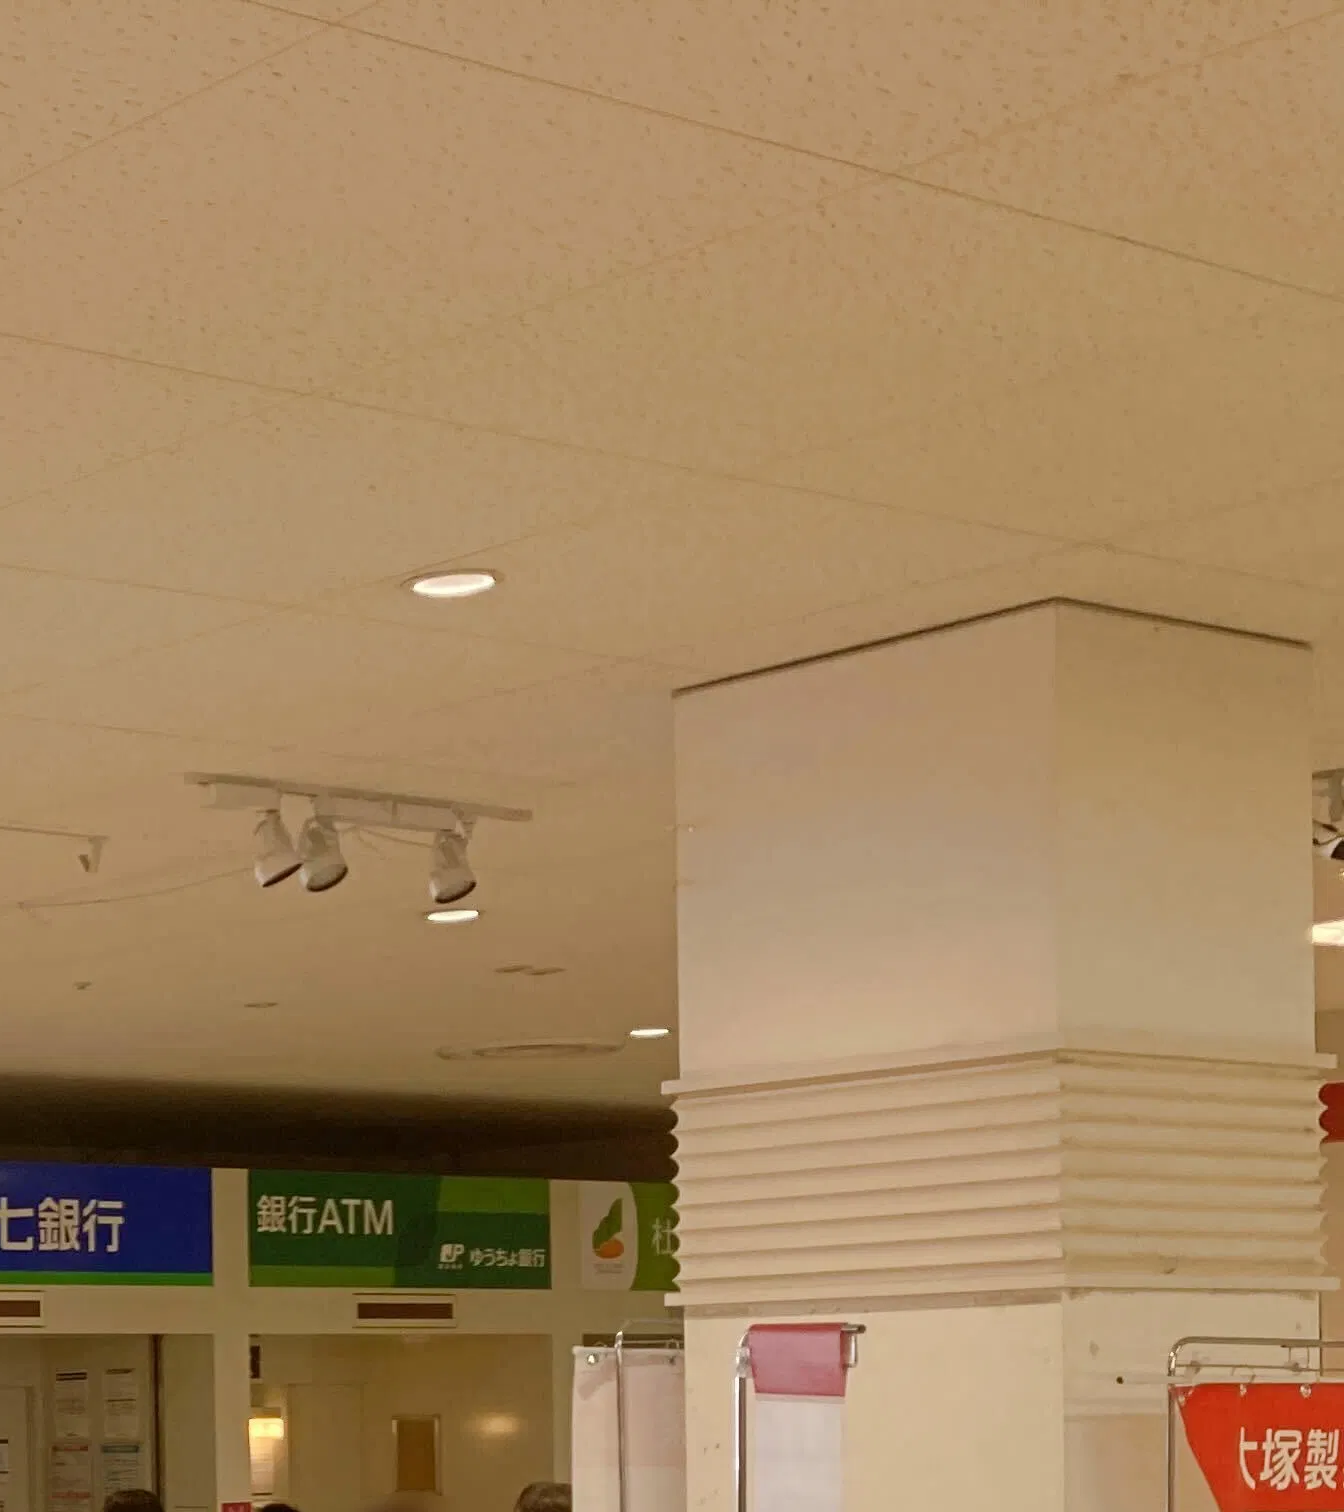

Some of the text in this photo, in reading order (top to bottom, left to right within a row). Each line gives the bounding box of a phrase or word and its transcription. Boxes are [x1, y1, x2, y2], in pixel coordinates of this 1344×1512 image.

[256, 1195, 394, 1236] 銀行ATM
[469, 1247, 546, 1268] ゆうちょ銀行
[1239, 1426, 1344, 1491] 大塚製
